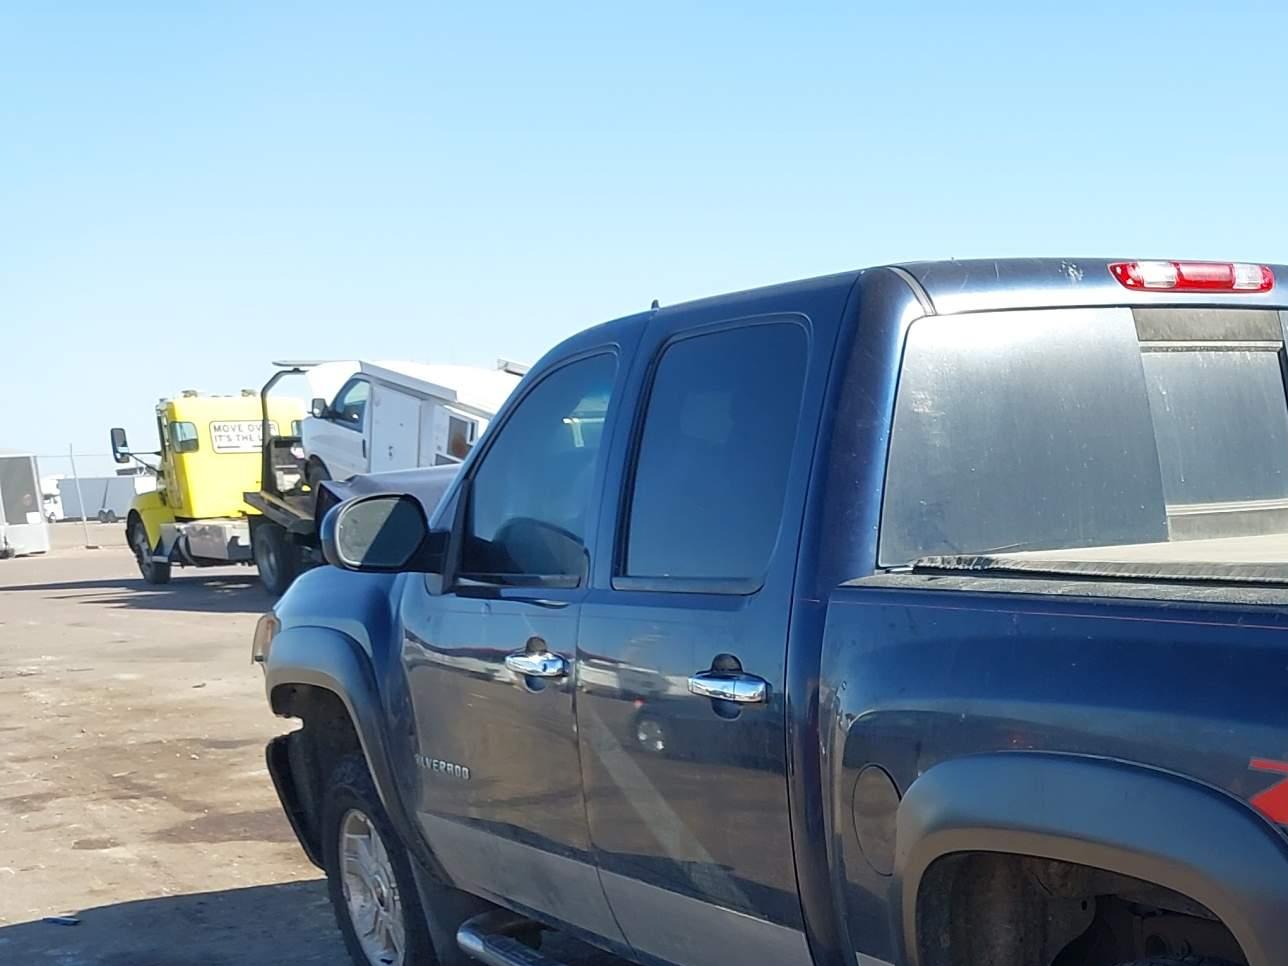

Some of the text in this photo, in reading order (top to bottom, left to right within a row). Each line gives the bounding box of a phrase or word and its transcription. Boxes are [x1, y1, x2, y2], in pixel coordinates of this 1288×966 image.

[213, 423, 276, 433] MOVE OVR
[236, 434, 255, 442] THE
